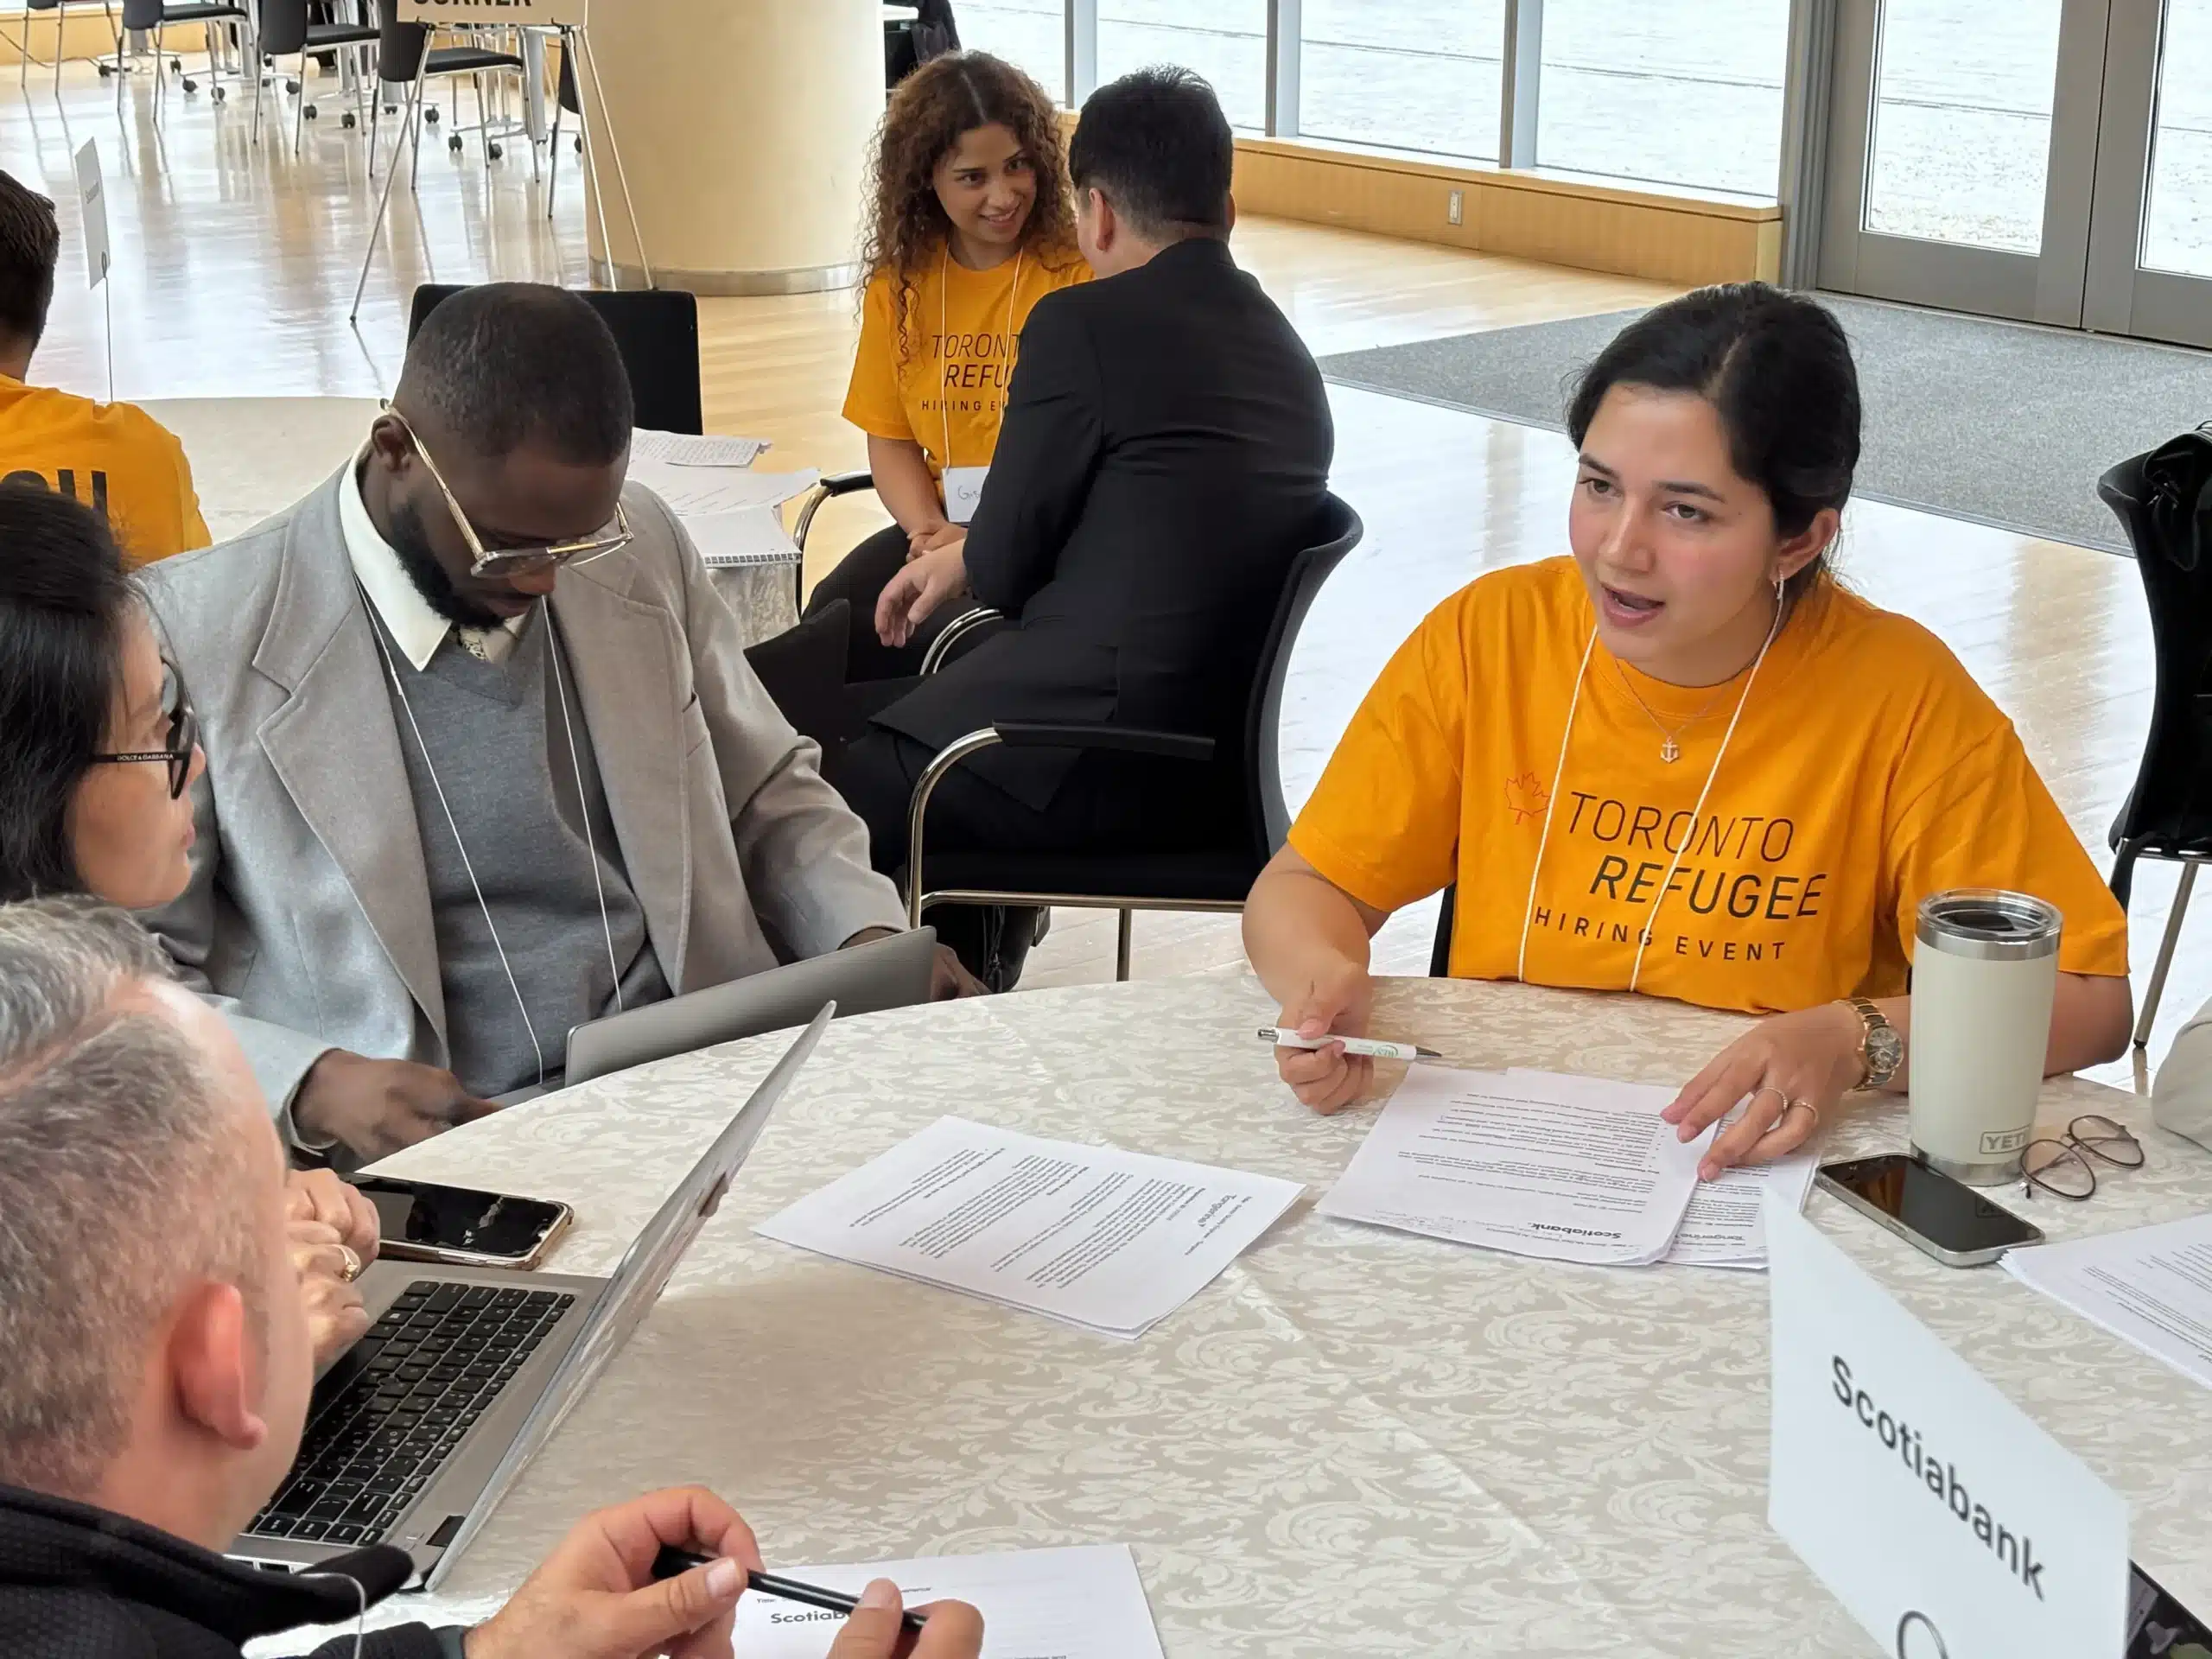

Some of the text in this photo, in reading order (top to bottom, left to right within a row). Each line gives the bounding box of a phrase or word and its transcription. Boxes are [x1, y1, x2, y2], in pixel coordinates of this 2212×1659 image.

[931, 334, 1020, 359] TORONT
[944, 364, 1010, 389] REFU
[1568, 791, 1794, 862] TORONTO
[1589, 855, 1827, 920] REFUGEE
[1535, 906, 1786, 961] HIRING EVENT
[1831, 1355, 2045, 1602] Scotiabank
[771, 1611, 847, 1624] Scotiab
